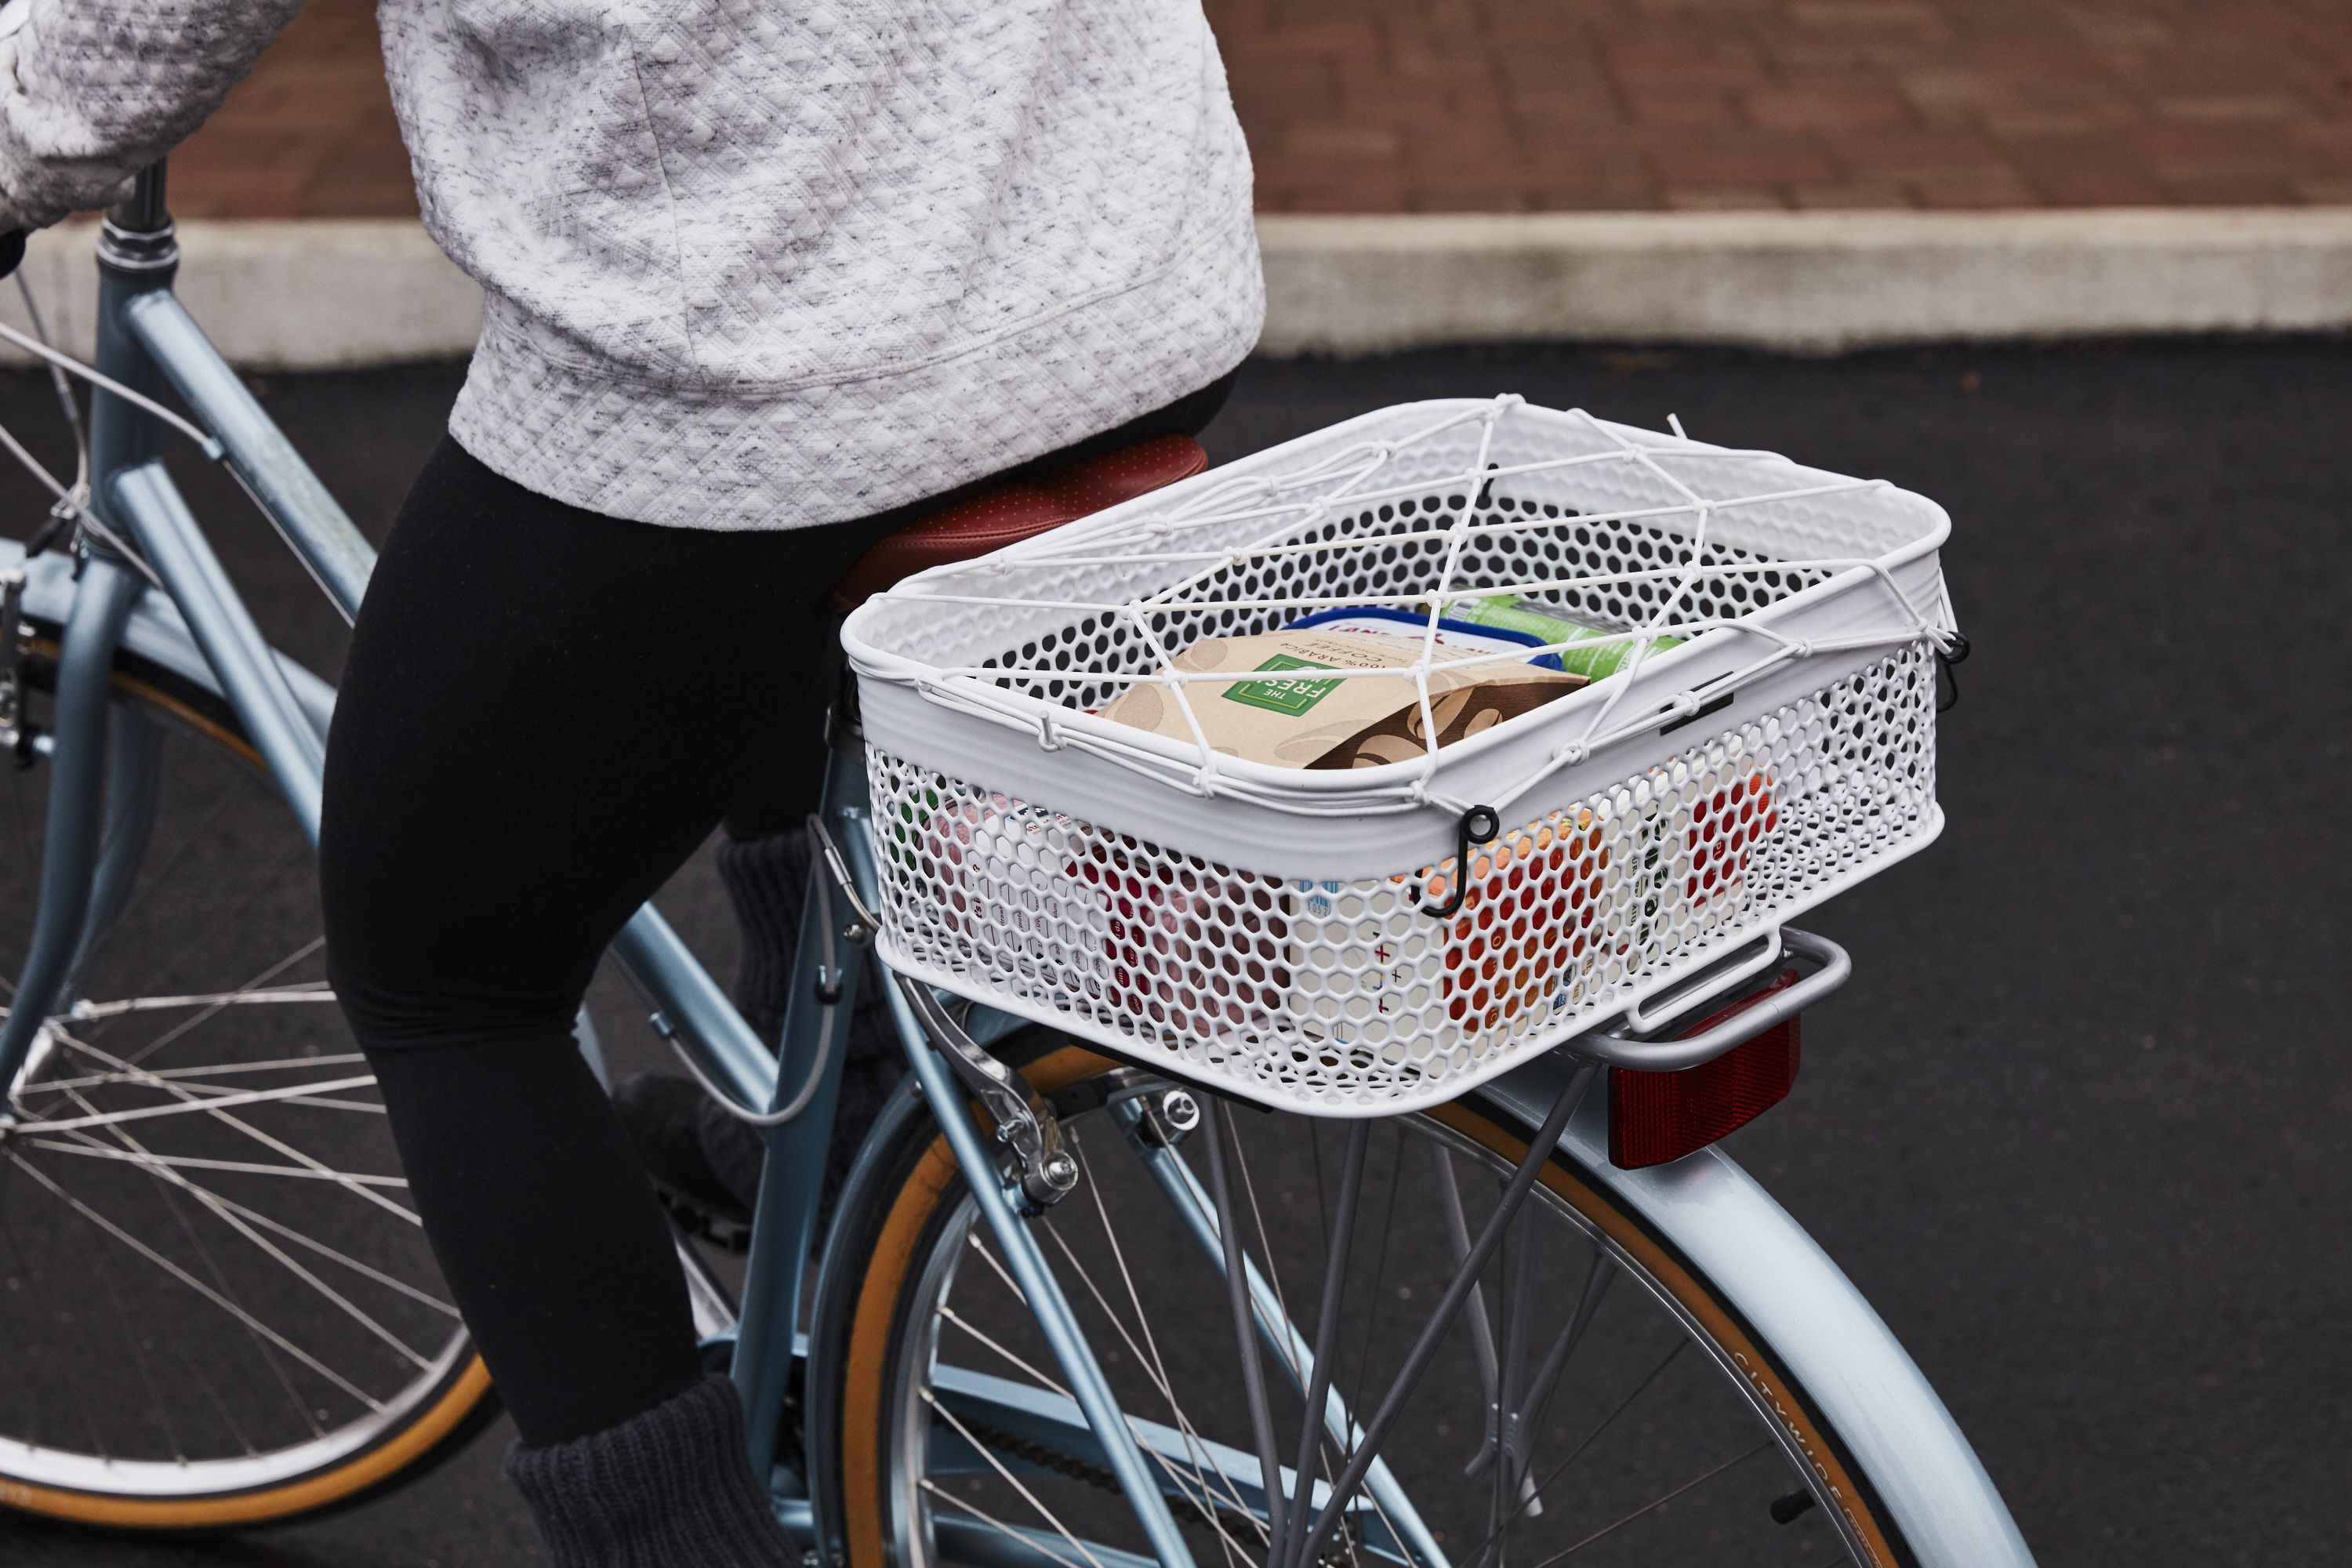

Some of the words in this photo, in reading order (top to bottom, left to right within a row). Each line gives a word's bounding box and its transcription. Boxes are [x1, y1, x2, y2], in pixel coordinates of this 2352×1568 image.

[1279, 643, 1341, 662] ARABICA
[1305, 643, 1382, 662] COFFEE
[1256, 679, 1327, 699] FRES
[1263, 688, 1287, 699] THE
[1733, 1351, 1842, 1501] CITYWIDE
